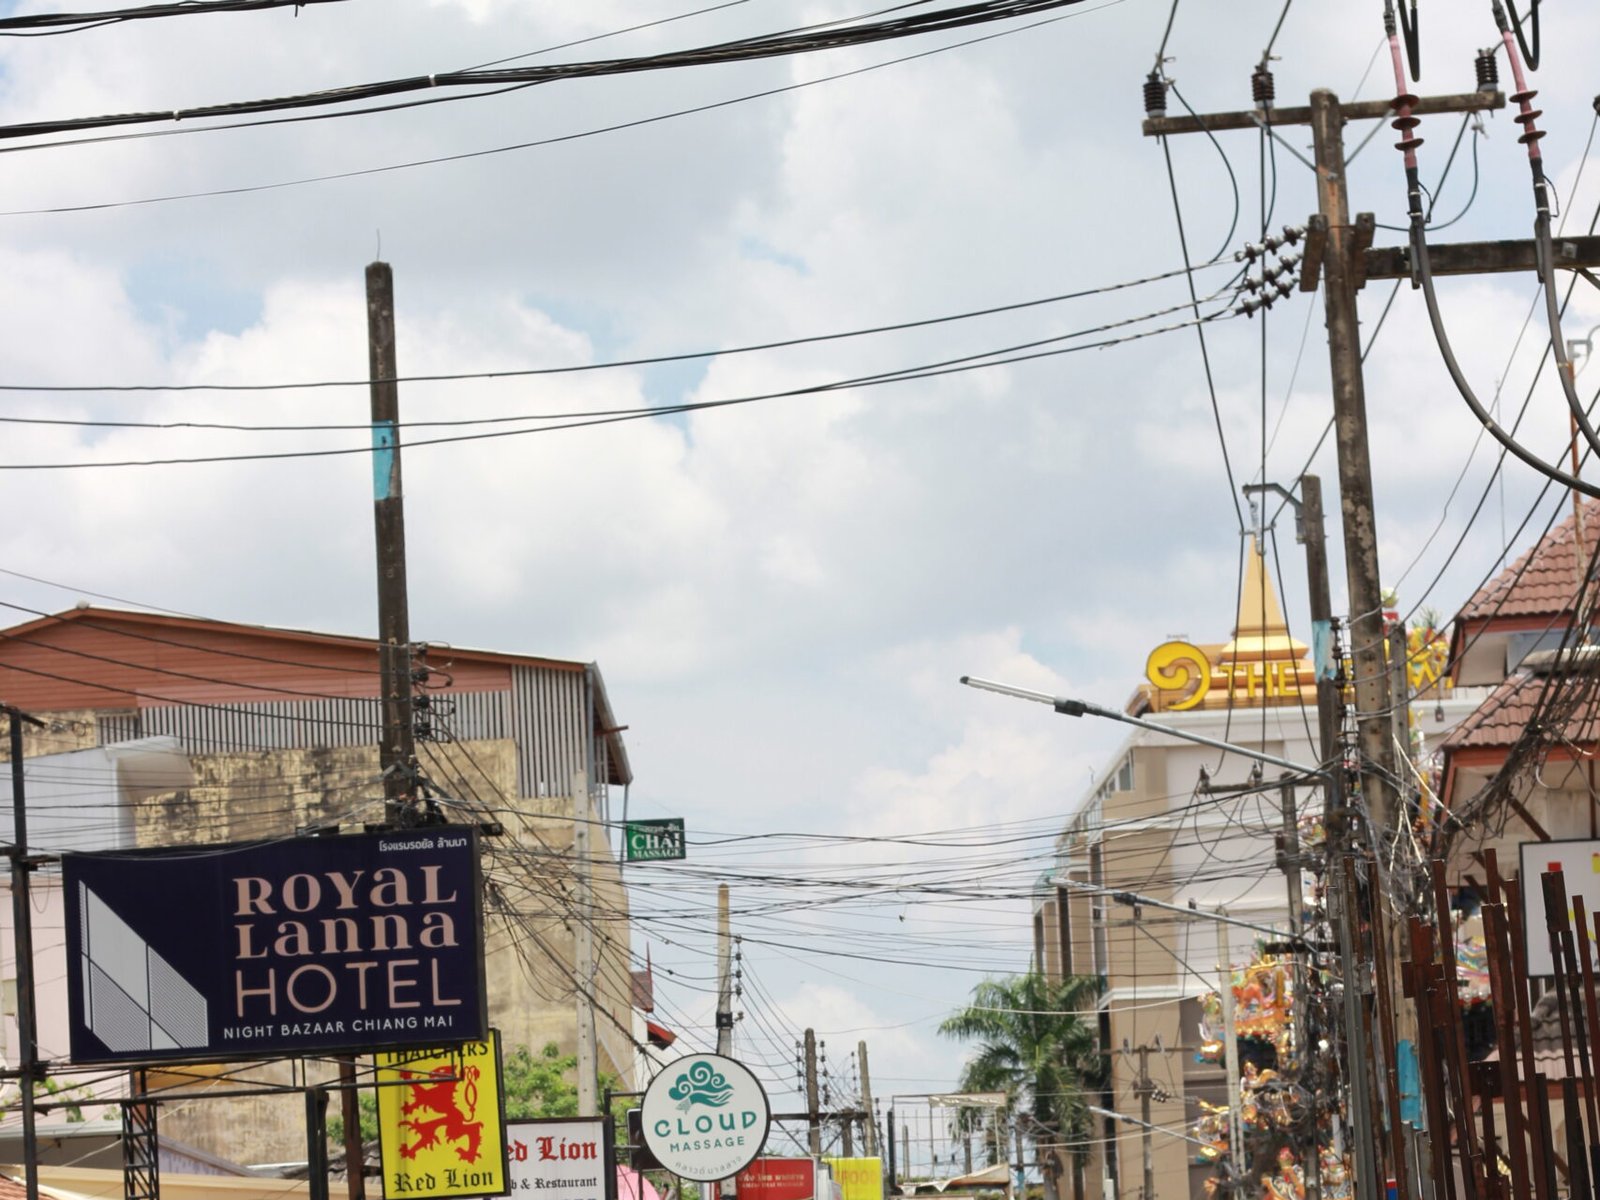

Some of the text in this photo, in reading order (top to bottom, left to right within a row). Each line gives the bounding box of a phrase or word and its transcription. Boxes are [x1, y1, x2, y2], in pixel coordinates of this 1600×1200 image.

[1218, 661, 1301, 700] THE
[379, 838, 434, 852] โรงแรมรอยัล
[633, 848, 681, 859] MASSAGE
[234, 911, 460, 959] Lanna
[236, 957, 462, 1018] HOTEL
[223, 1015, 453, 1039] NIGHT BAZAAR CHIANG MAI
[654, 1110, 757, 1138] CLOUD
[507, 1136, 598, 1162] ed Lion
[670, 1136, 745, 1153] MASSAGE
[394, 1172, 436, 1193] Red
[444, 1167, 494, 1189] Lion
[520, 1178, 531, 1190] &
[535, 1176, 598, 1189] Restaurant
